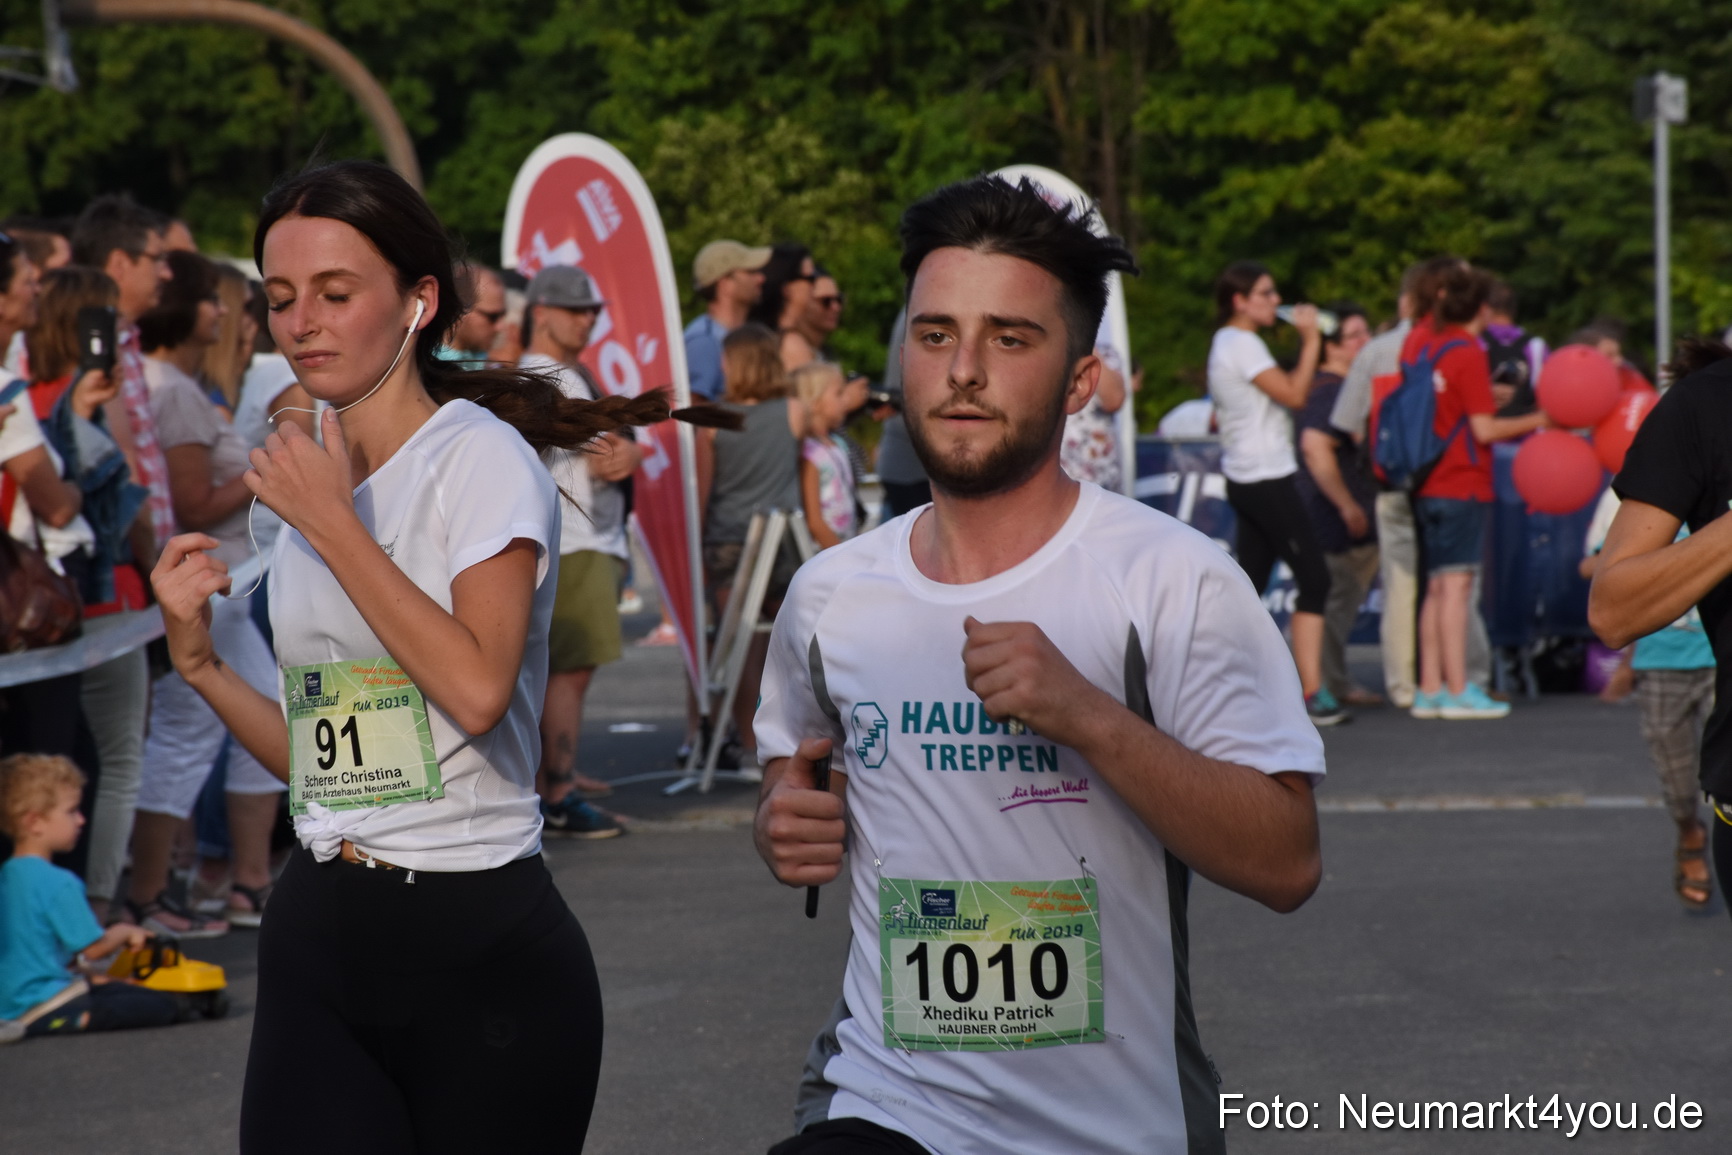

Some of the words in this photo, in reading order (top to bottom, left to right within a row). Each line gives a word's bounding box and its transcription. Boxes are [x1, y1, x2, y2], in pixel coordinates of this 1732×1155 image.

[299, 691, 340, 709] firmenlauf
[353, 699, 371, 712] run
[377, 695, 409, 710] 2019
[902, 701, 1042, 736] HAUB
[315, 715, 363, 770] 91
[921, 744, 1059, 772] TREPPEN
[305, 775, 338, 788] Scherer
[341, 768, 402, 785] Christina
[1030, 784, 1060, 798] bessere
[1061, 778, 1090, 793] Wahl
[302, 790, 313, 800] BAG
[314, 790, 322, 799] im
[323, 786, 362, 798] Ärztehaus
[364, 780, 411, 794] Neumarkt
[908, 913, 990, 930] firmenlauf
[1009, 927, 1036, 940] run
[1043, 924, 1083, 939] 2019
[906, 942, 1069, 1003] 1010
[922, 1005, 988, 1021] Xhediku
[994, 1003, 1054, 1021] Patrick
[938, 1024, 997, 1034] HAUBNER
[999, 1022, 1037, 1034] GmbH
